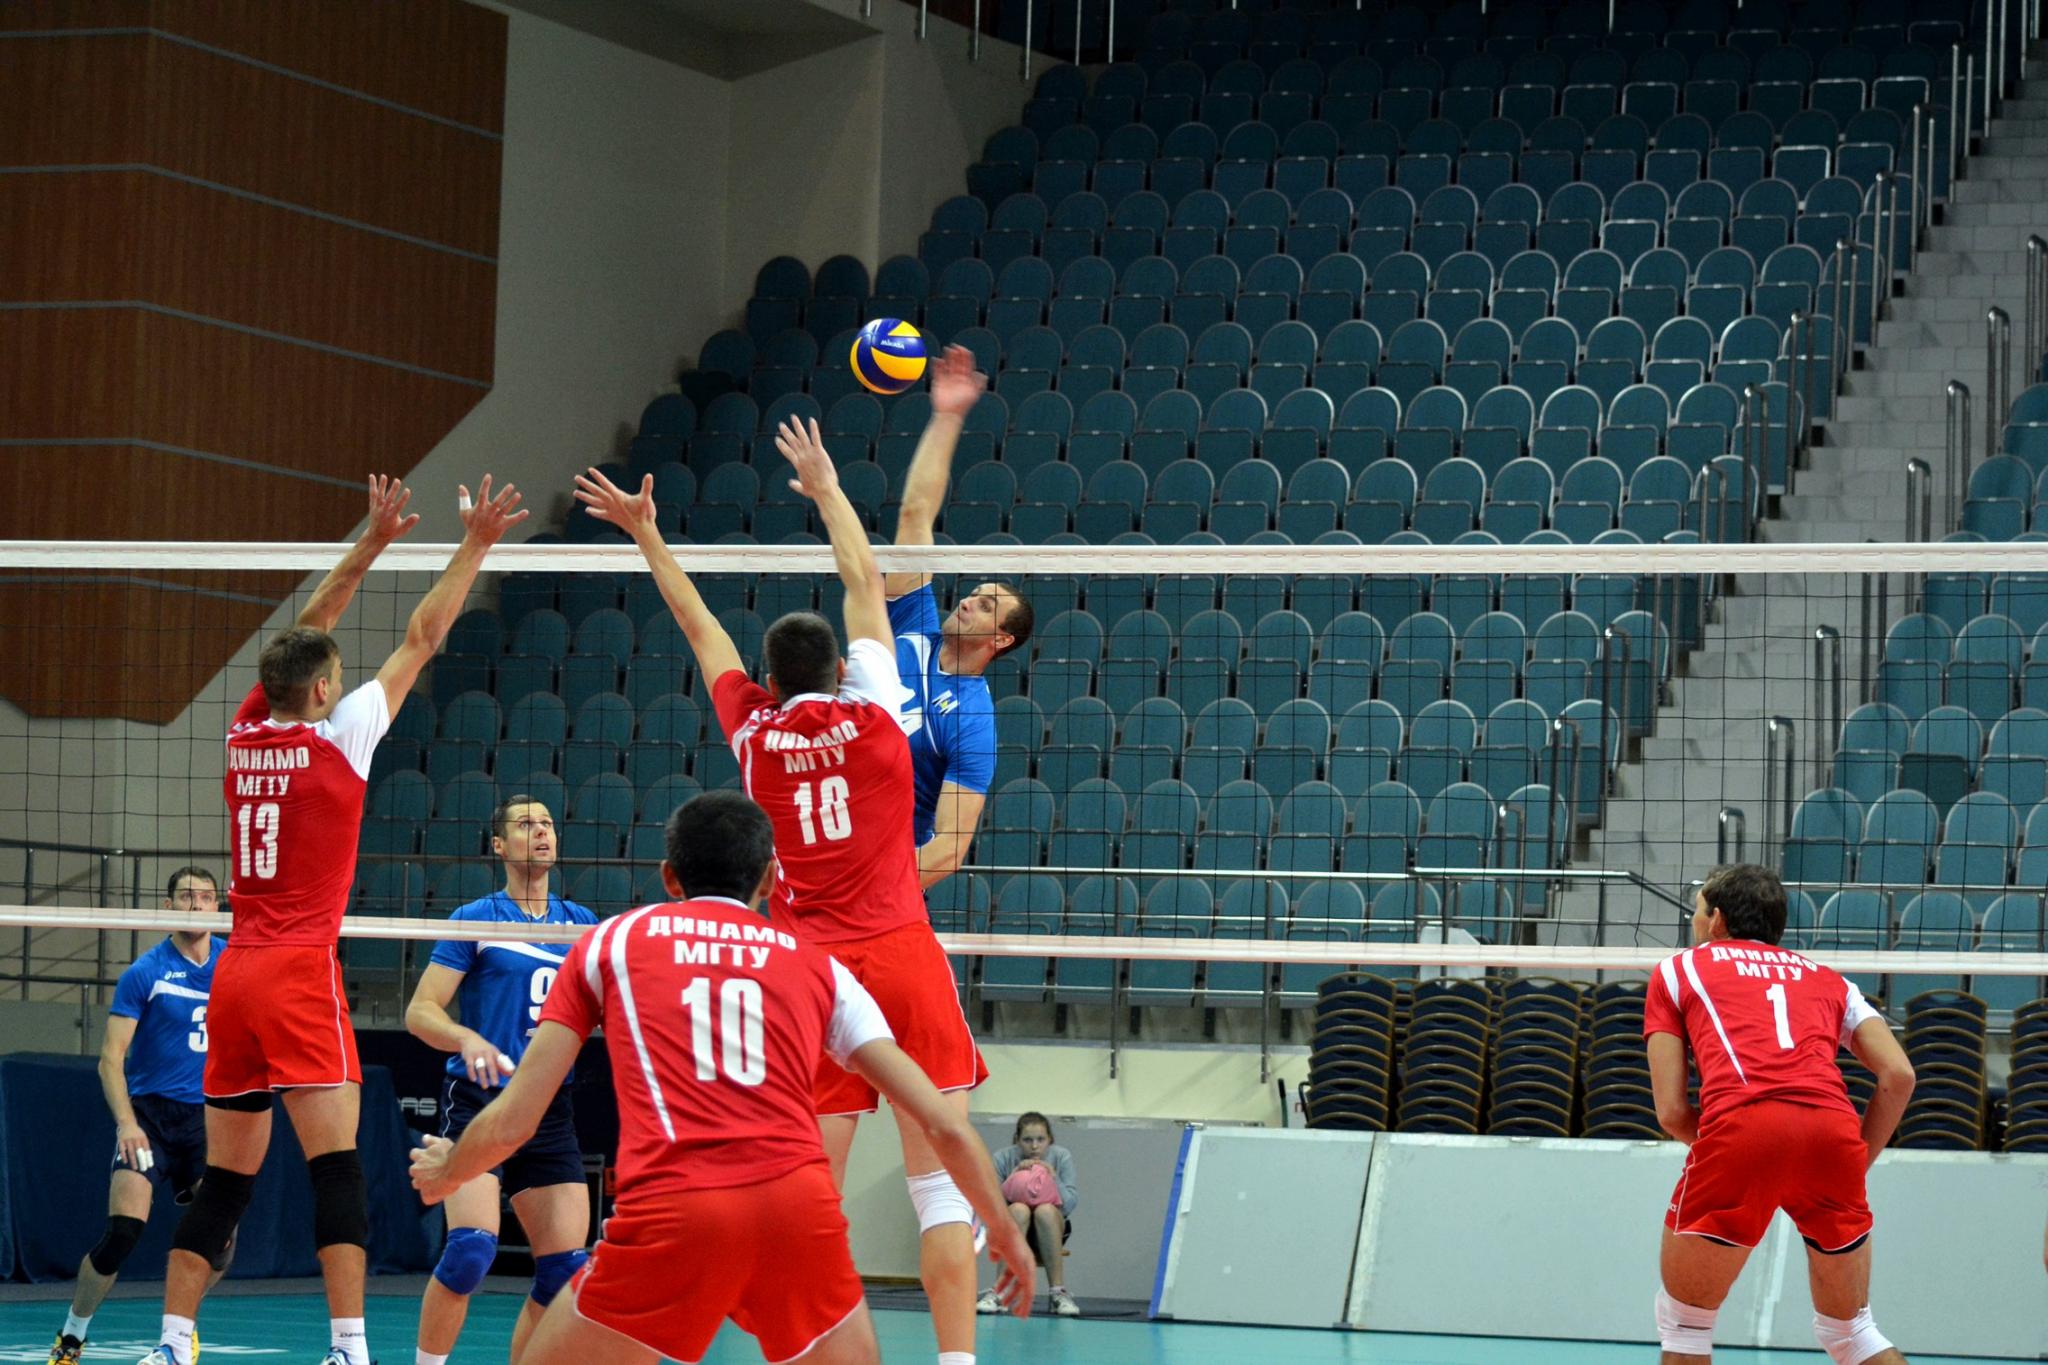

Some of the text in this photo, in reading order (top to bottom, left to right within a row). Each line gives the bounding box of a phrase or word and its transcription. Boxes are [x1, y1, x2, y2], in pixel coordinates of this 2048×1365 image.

[229, 746, 310, 771] ДИНАМО
[783, 745, 846, 774] МГТУ
[236, 774, 290, 796] МГТУ
[238, 803, 280, 879] 13
[646, 915, 797, 951] ДИНАМО
[674, 940, 771, 969] МГТУ
[1710, 946, 1818, 973] ДИНАМО
[1735, 960, 1804, 981] МГТУ
[529, 966, 559, 1022] 9
[188, 1005, 208, 1053] 3
[681, 977, 766, 1086] 10
[1765, 983, 1795, 1049] 1
